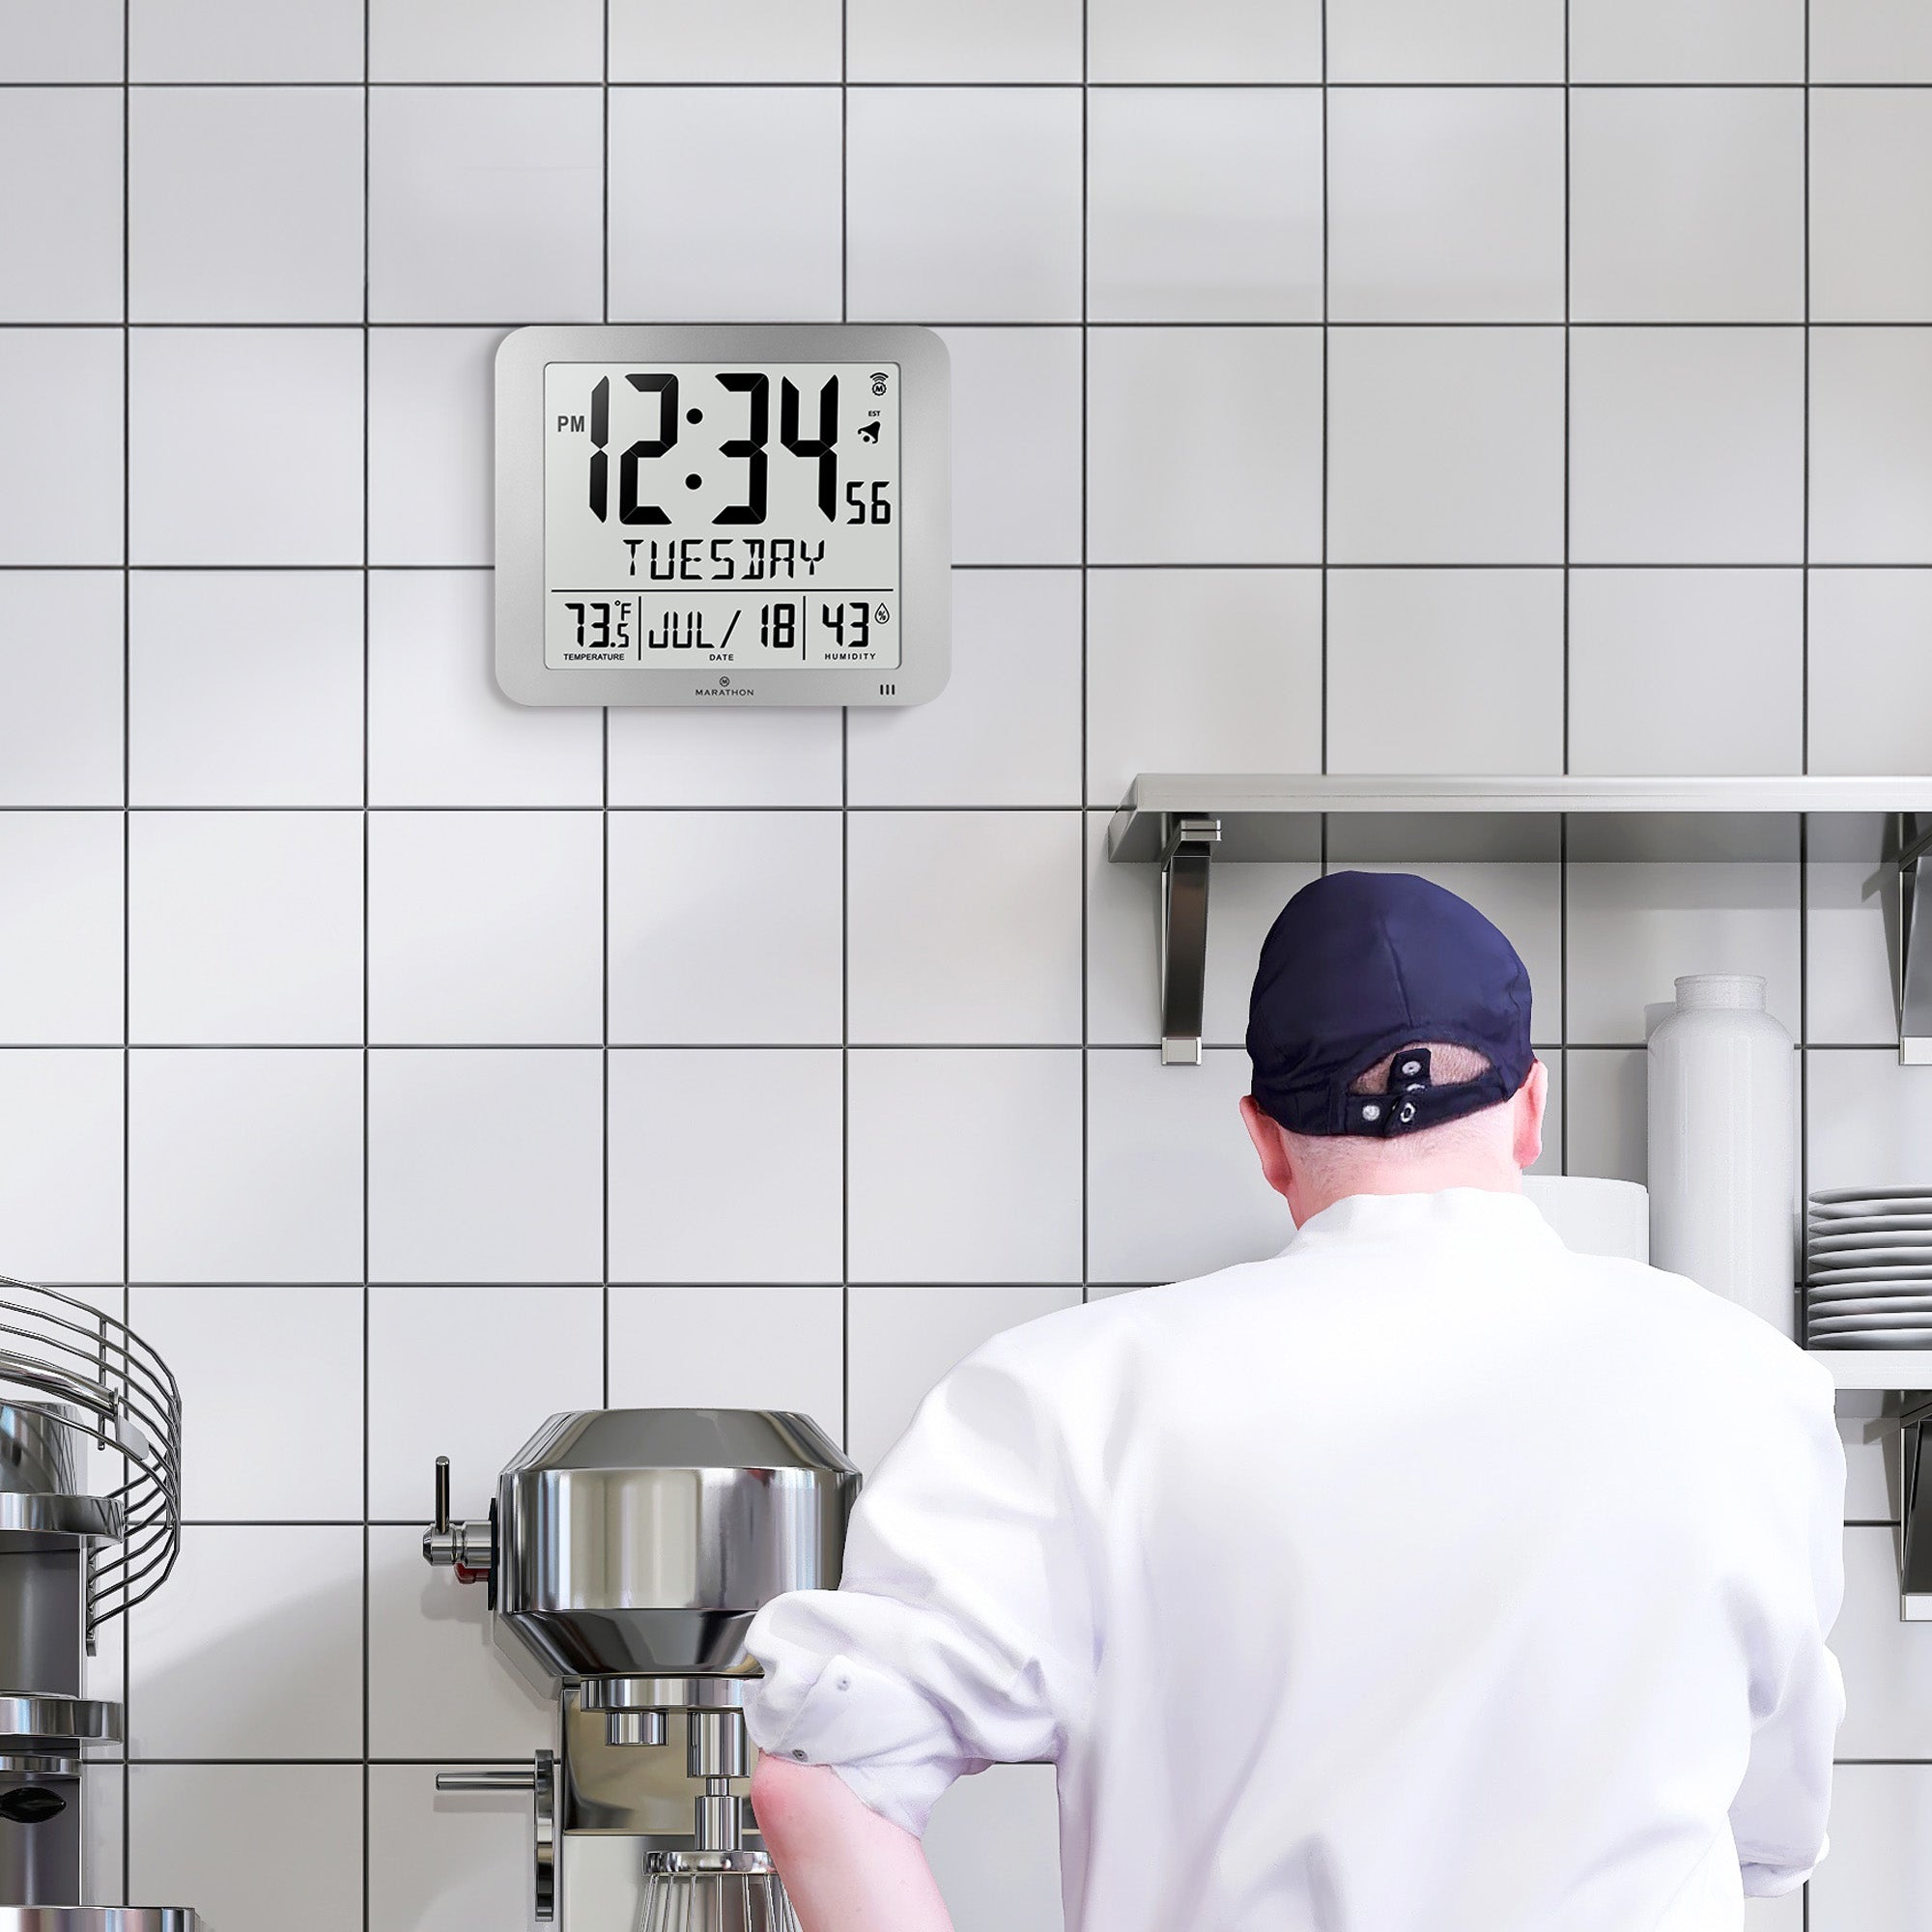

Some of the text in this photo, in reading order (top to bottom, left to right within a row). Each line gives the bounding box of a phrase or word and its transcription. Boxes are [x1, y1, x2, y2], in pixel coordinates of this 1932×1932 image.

[557, 373, 839, 526] PM 12:34
[846, 481, 892, 526] 56
[623, 538, 825, 580] TUESDAY
[761, 604, 796, 648] 18
[822, 603, 869, 647] 43
